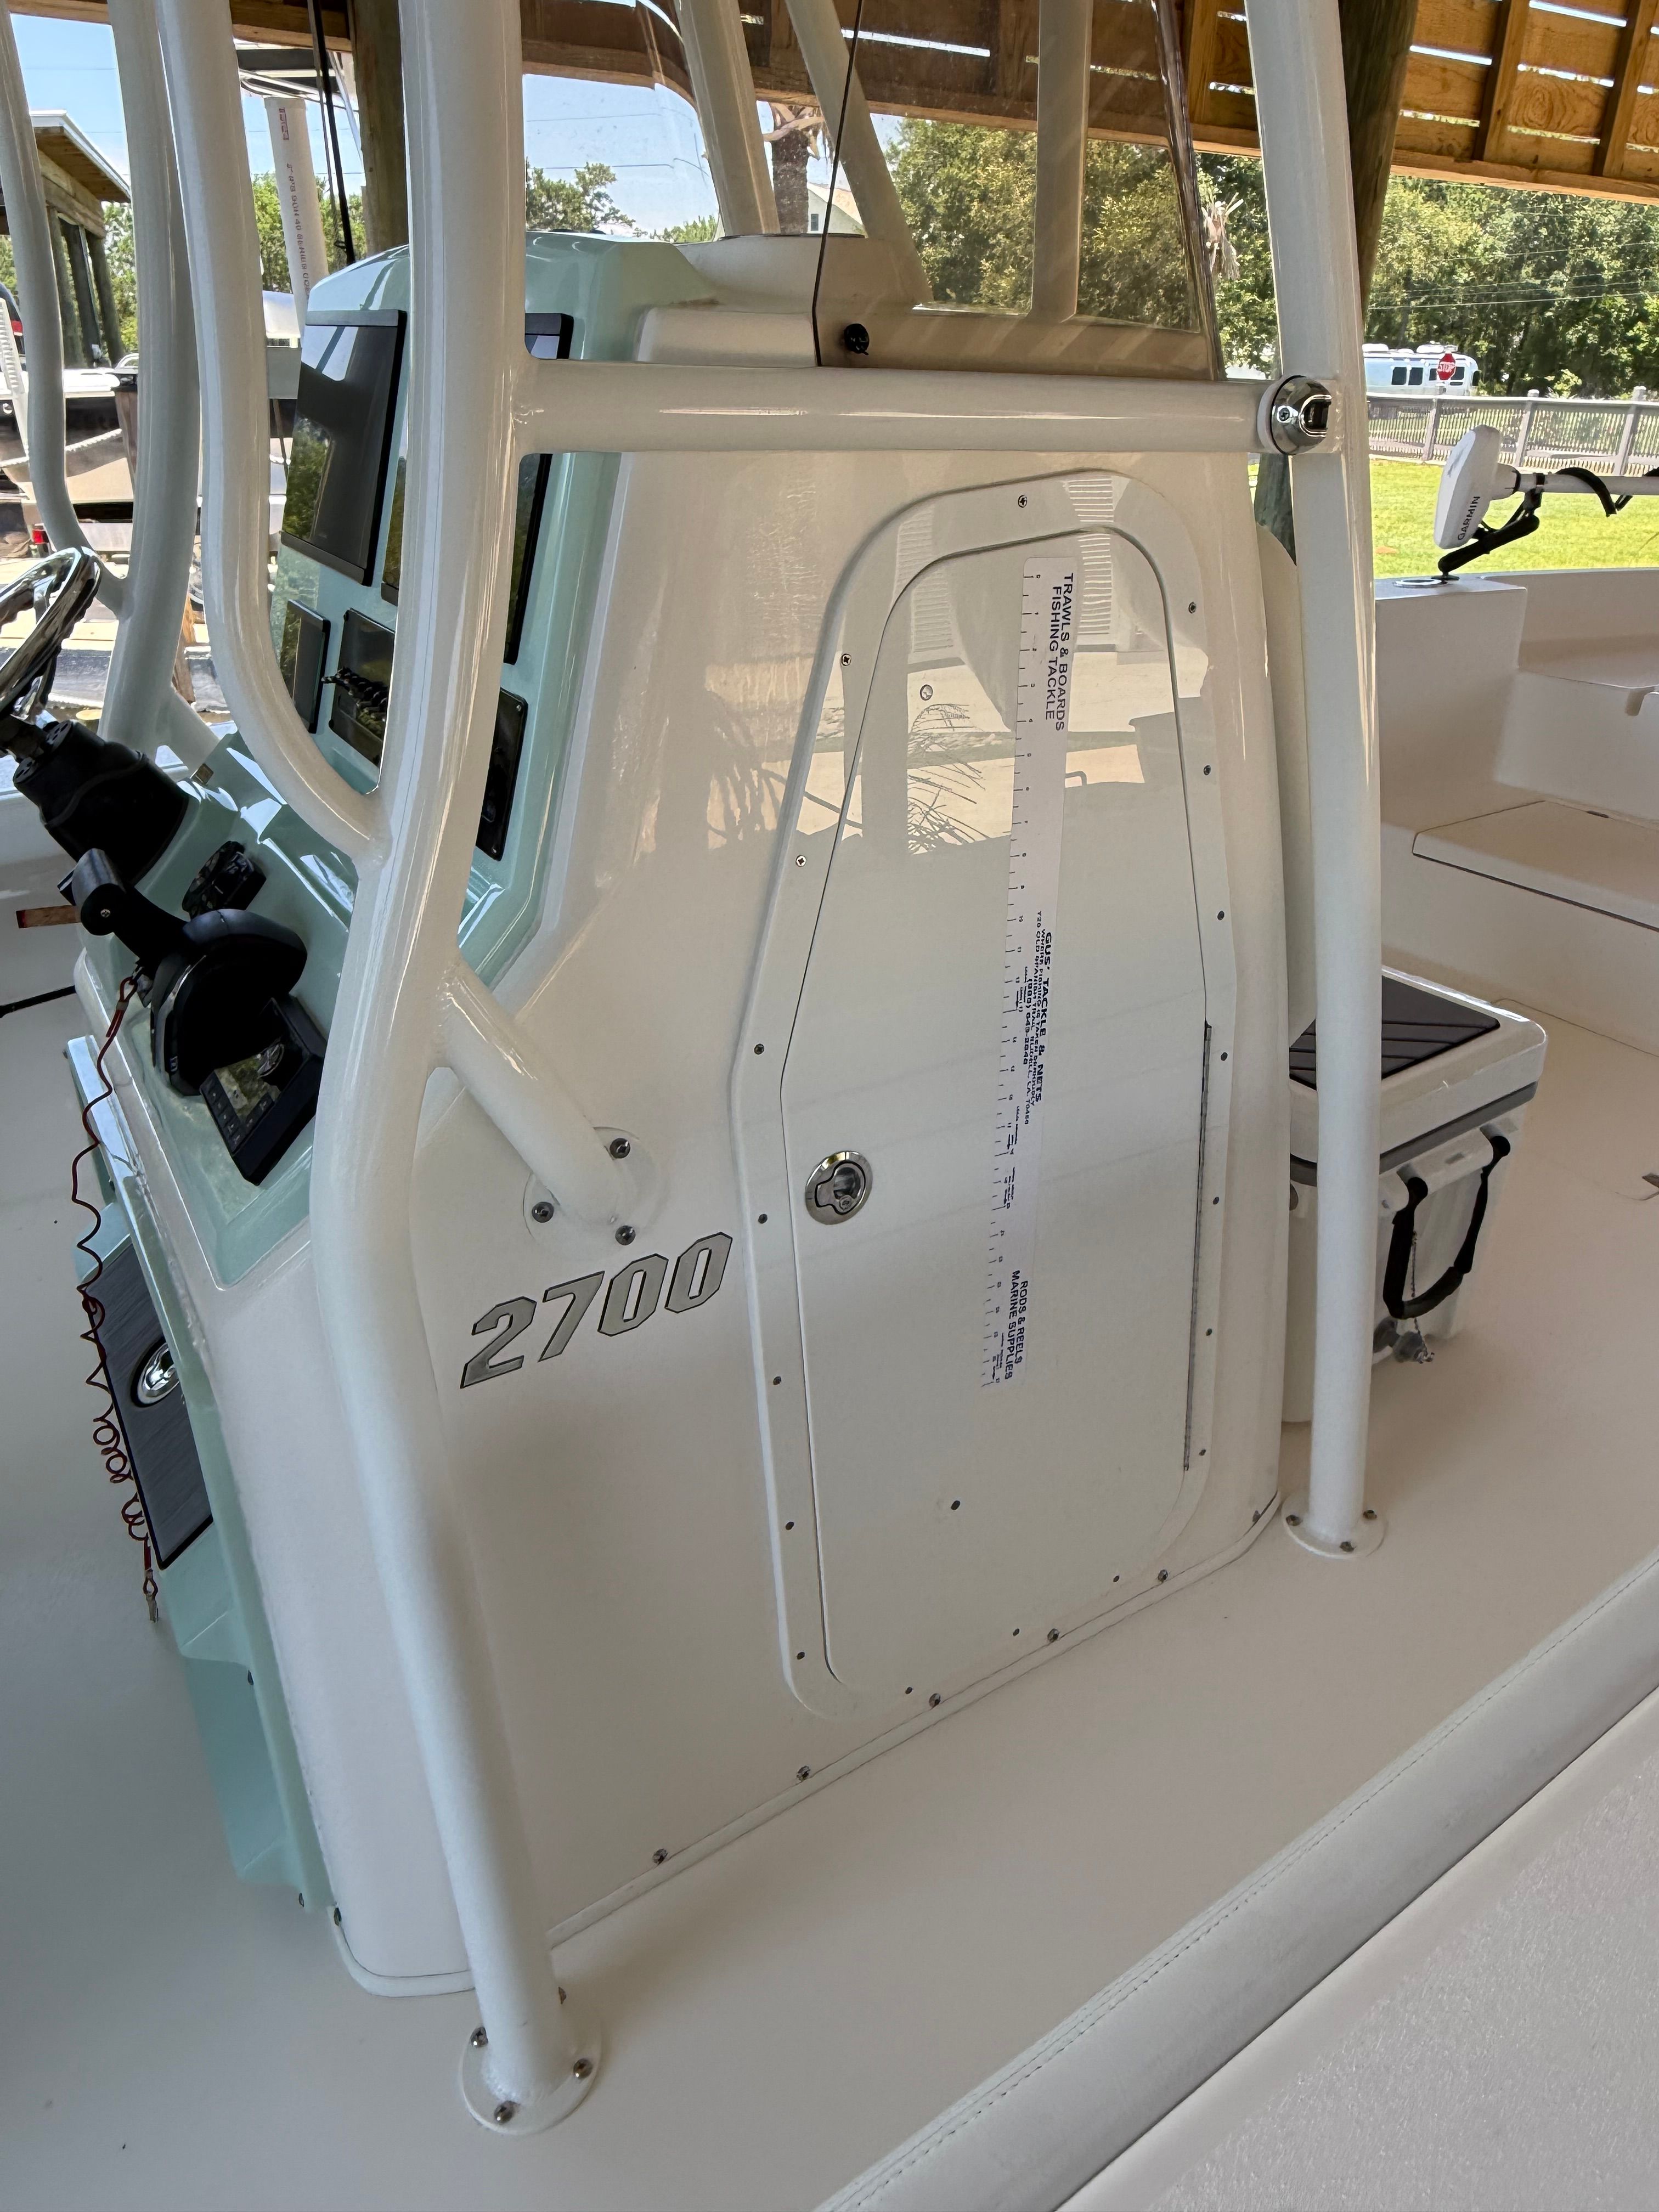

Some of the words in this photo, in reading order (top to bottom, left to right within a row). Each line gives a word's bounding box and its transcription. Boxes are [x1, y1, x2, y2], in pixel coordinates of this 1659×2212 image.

[1437, 362, 1455, 373] STOP
[1458, 496, 1480, 540] GARMIN
[1049, 586, 1062, 652] FISHING
[1060, 573, 1074, 642] TRAWLS
[1060, 647, 1069, 658] &
[1046, 656, 1058, 720] TACKLE
[1056, 663, 1068, 731] BOARDS
[1040, 978, 1049, 1036] TACKLE
[1039, 1045, 1045, 1056] &
[460, 1232, 733, 1389] 2700
[1009, 1270, 1020, 1319] MARINE
[1019, 1280, 1028, 1313] RODS
[1005, 1322, 1017, 1379] SUPPLIES
[1014, 1327, 1025, 1364] REELS
